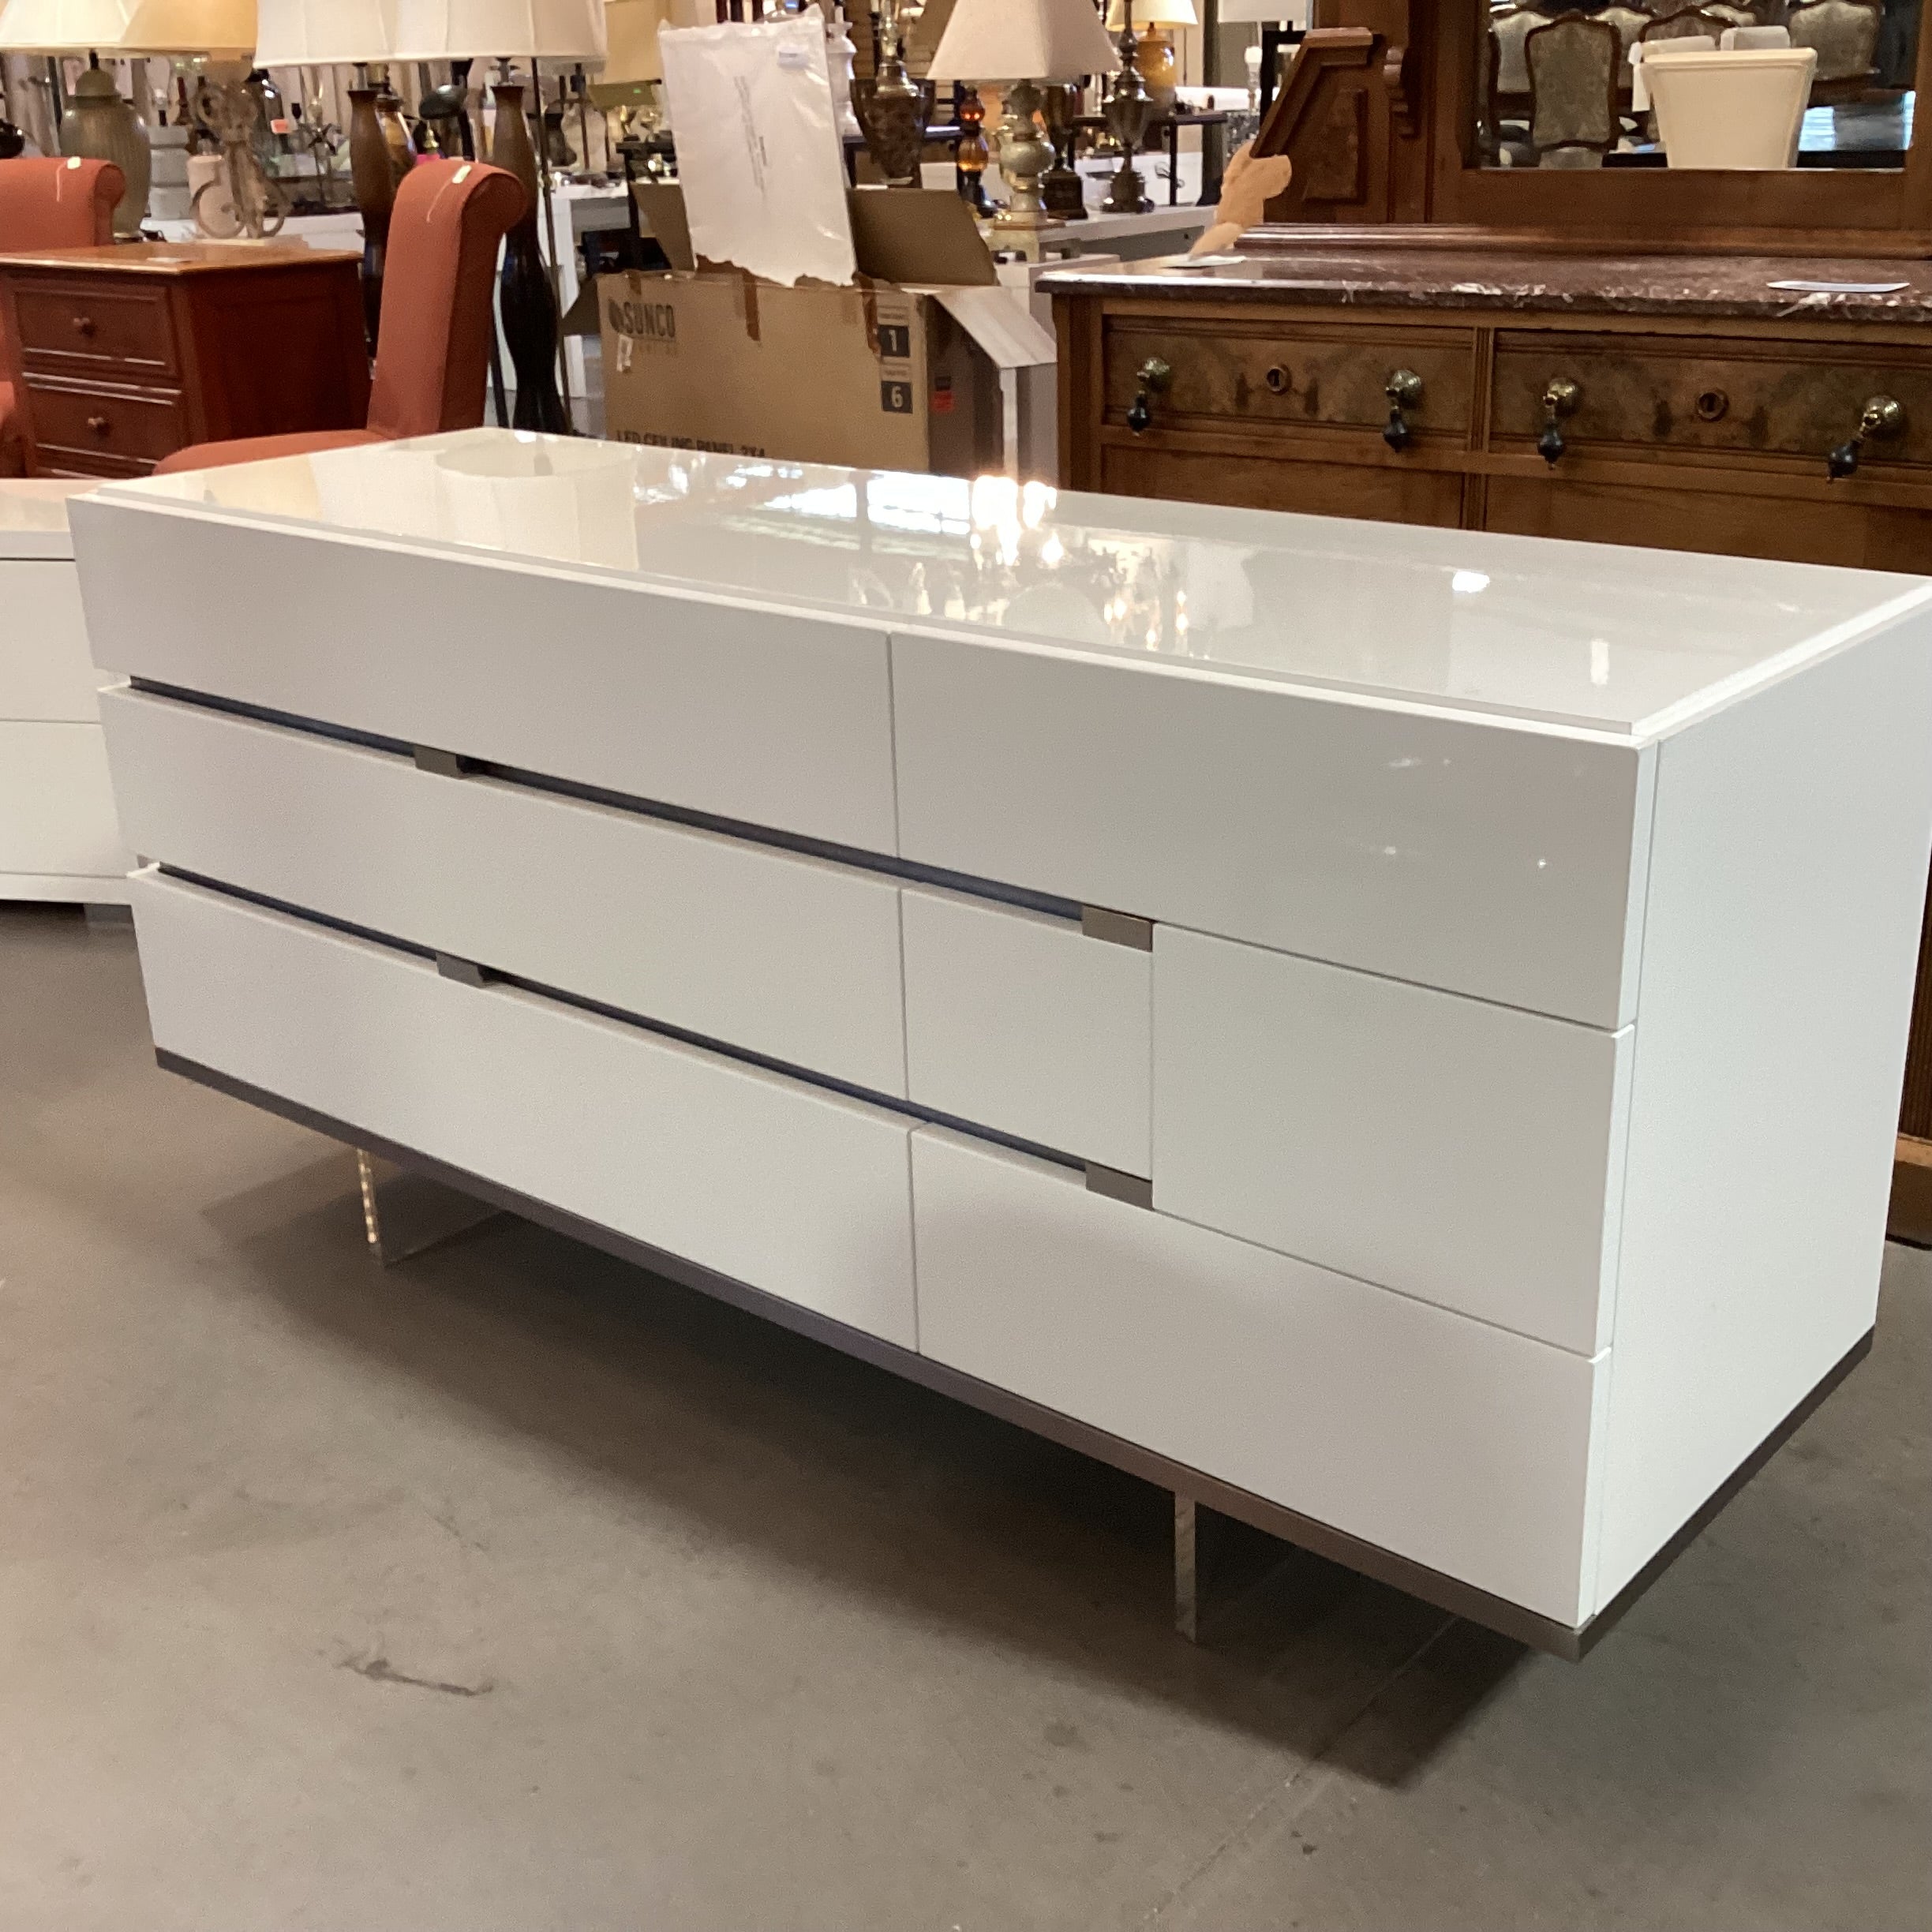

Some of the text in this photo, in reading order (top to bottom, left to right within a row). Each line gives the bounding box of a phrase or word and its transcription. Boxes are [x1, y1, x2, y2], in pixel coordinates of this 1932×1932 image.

[623, 301, 676, 338] SUNCO
[888, 329, 898, 352] 1
[891, 385, 904, 409] 6
